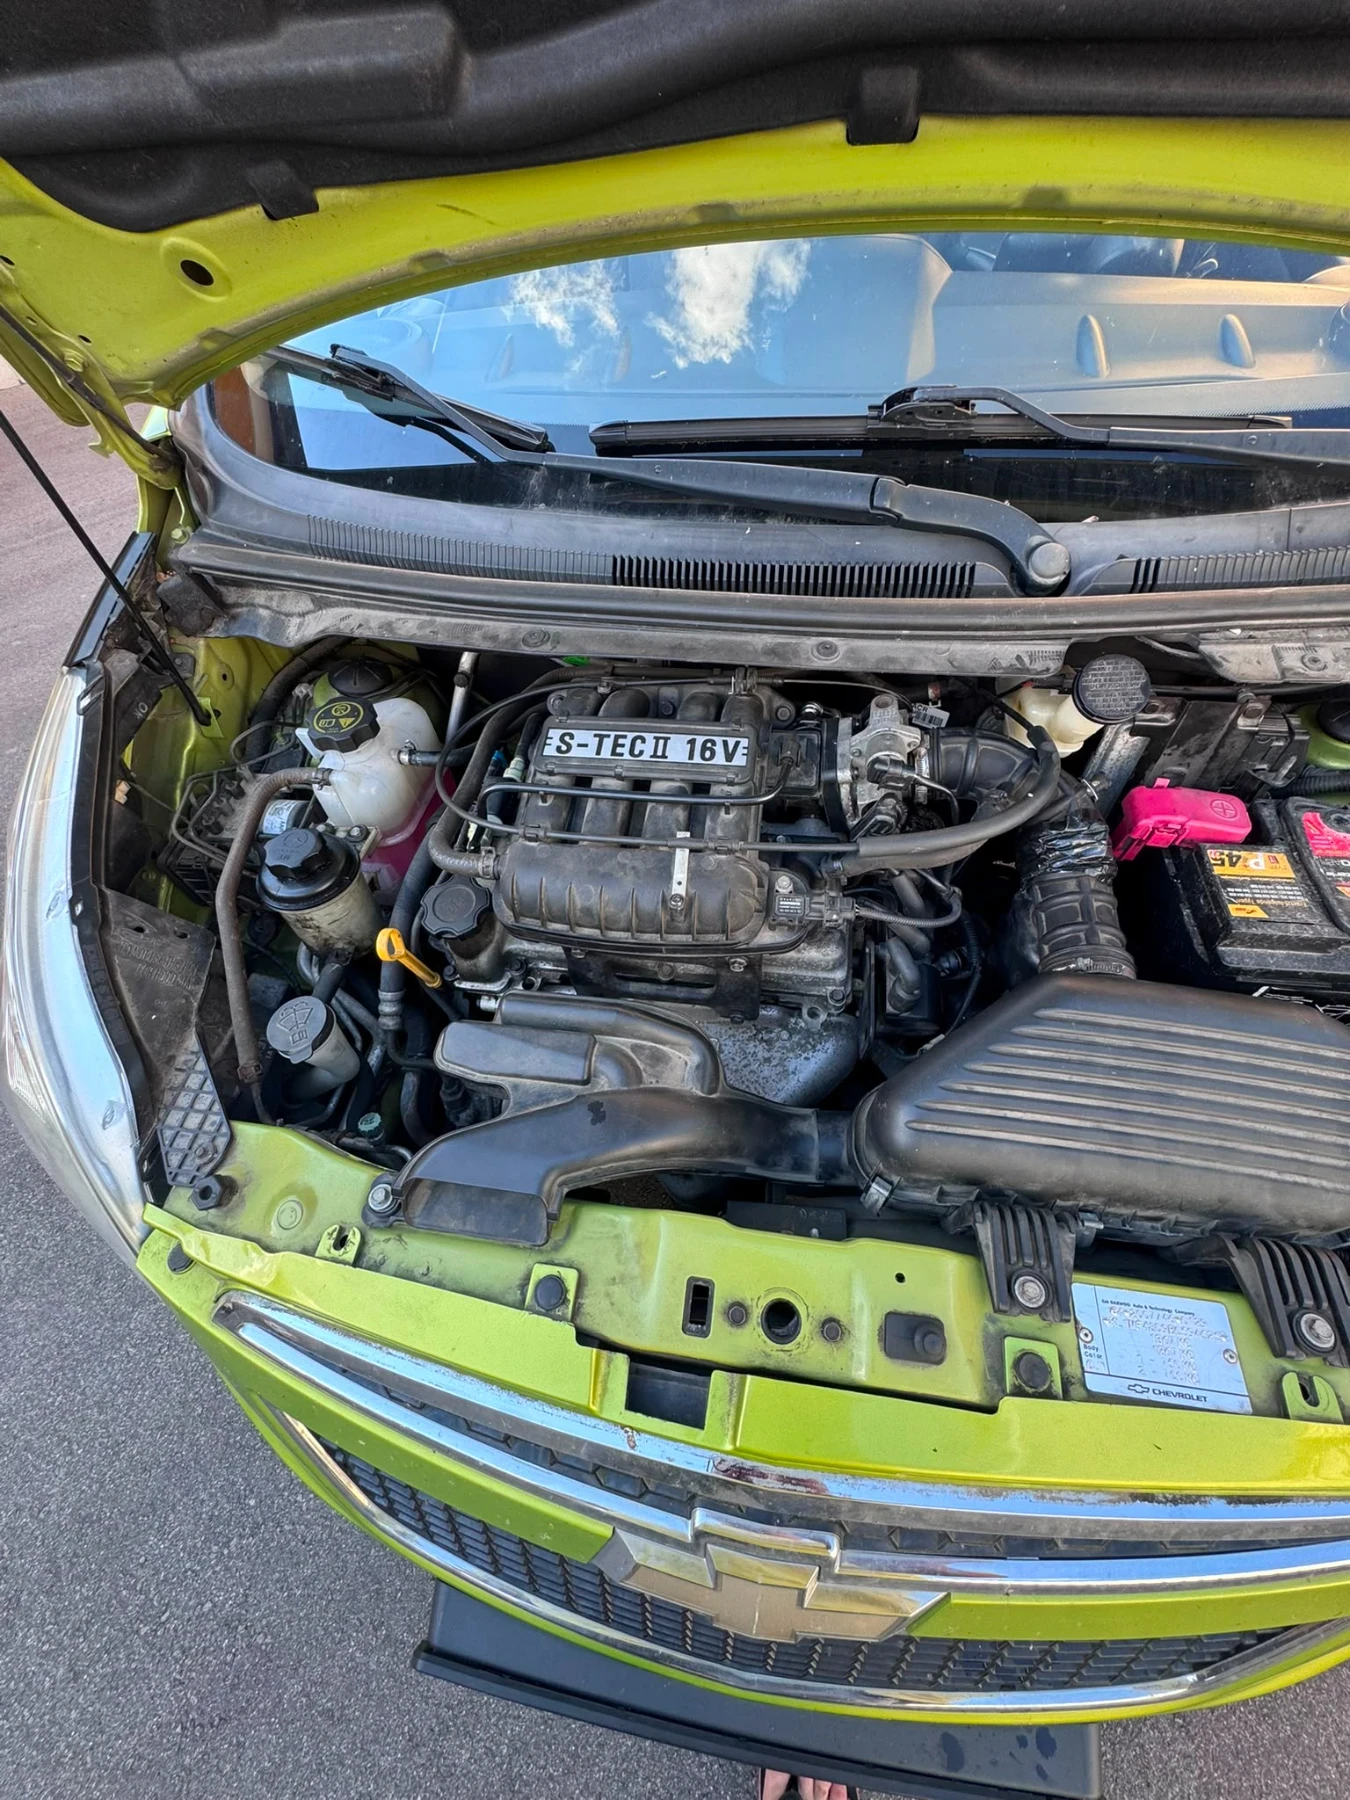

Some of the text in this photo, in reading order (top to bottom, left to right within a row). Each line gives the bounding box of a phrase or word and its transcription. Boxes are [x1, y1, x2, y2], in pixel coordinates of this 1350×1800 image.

[686, 737, 741, 763] 16V
[1149, 1305, 1172, 1313] Technology
[1083, 1344, 1098, 1352] Body
[1084, 1351, 1102, 1359] Color
[1152, 1388, 1208, 1402] CHEVROLET
